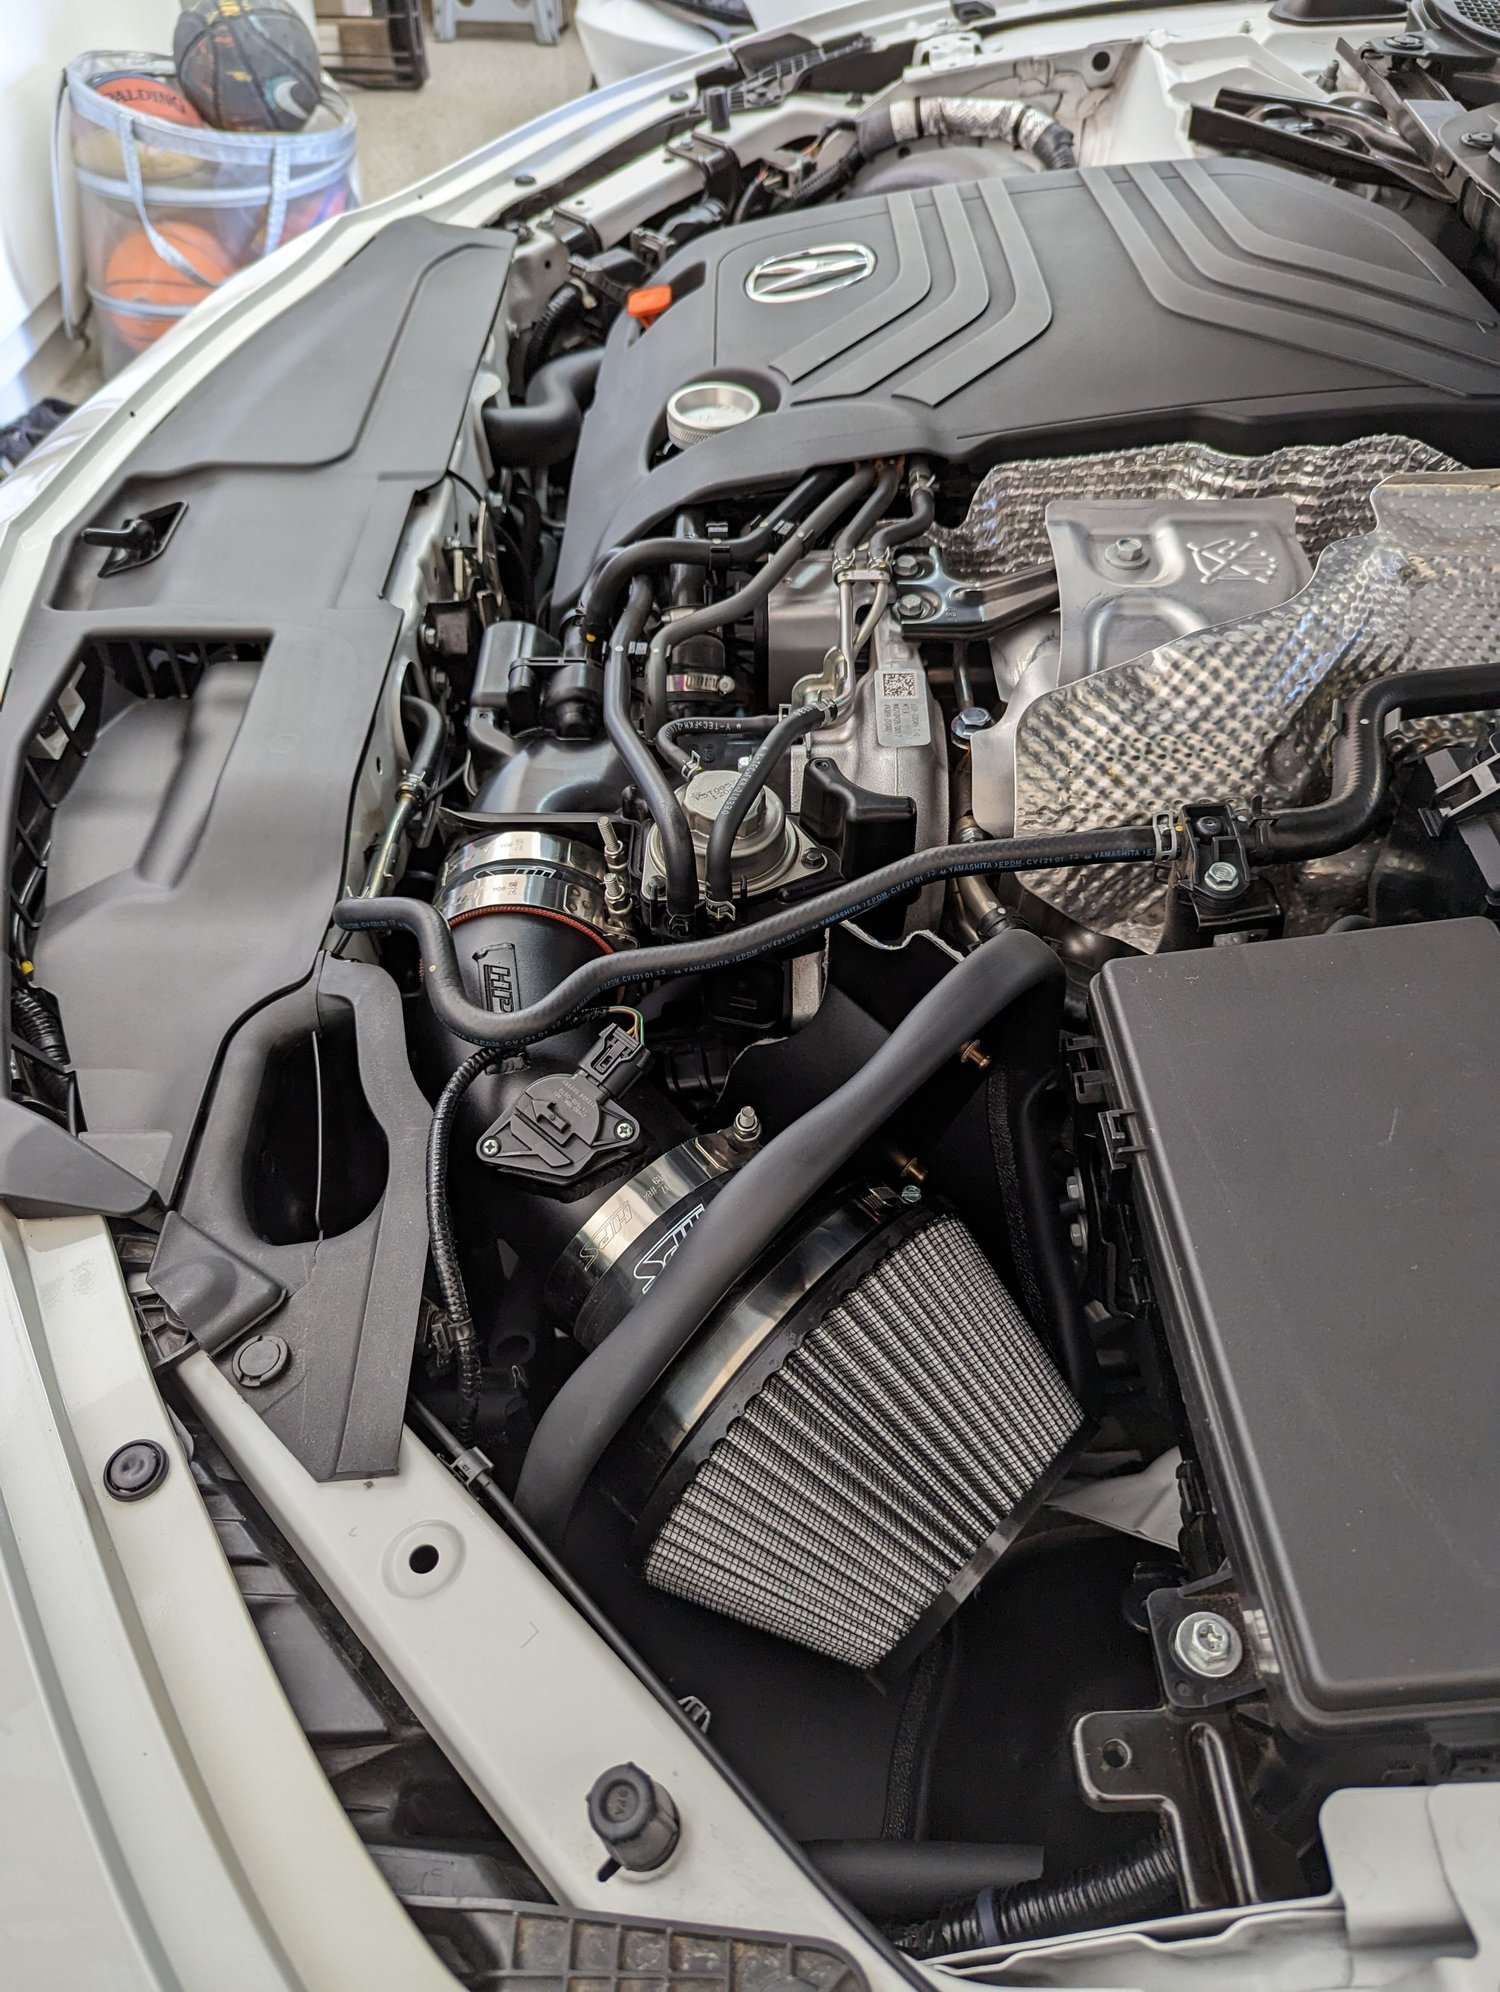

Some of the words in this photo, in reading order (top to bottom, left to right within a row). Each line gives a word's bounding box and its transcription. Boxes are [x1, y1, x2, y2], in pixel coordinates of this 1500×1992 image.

[103, 88, 187, 114] PALDING
[1094, 848, 1141, 858] YAMASHITA
[948, 862, 993, 873] YAMASHITA
[818, 904, 862, 927] YAMASHITA
[683, 958, 731, 973] YAMASHITA
[579, 1199, 634, 1273] HPS
